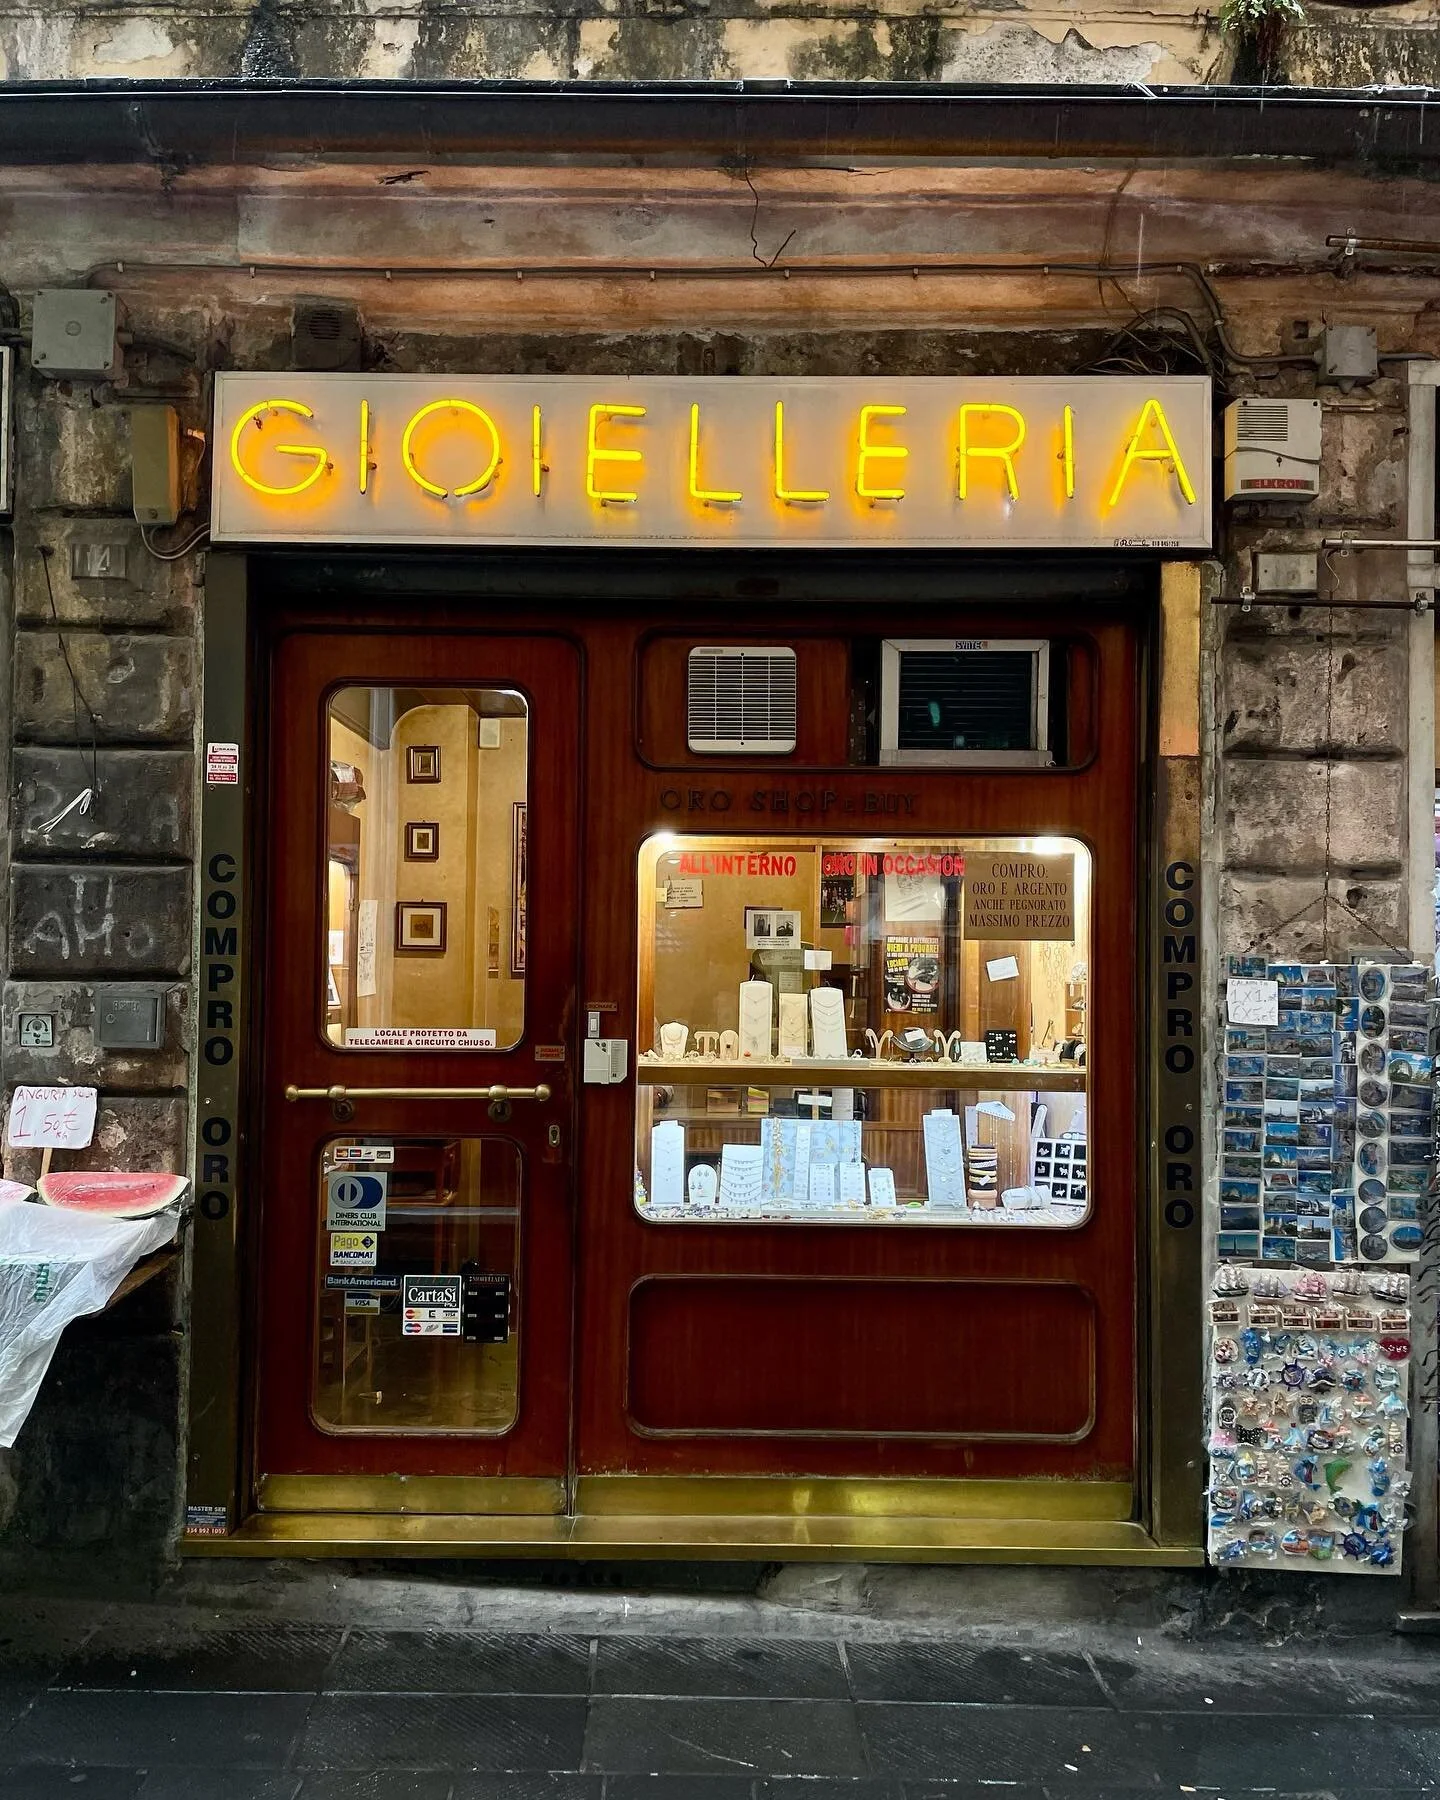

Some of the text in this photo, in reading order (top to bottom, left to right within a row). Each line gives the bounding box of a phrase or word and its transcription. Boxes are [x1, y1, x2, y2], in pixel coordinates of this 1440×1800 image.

[230, 399, 1197, 506] GIOIELLERIA
[661, 789, 731, 811] ORO
[751, 790, 837, 813] SHOP
[864, 792, 917, 815] BUY
[679, 853, 797, 877] ALL'INTERNO
[972, 881, 1067, 896] ORO E ARGENTO
[974, 899, 1066, 911] ANCHE PEGNORATO
[969, 914, 1070, 928] MASSIMO PREZZO
[202, 852, 237, 1221] COMPRO ORO
[348, 1038, 405, 1046] TELECAMERE
[1163, 860, 1196, 1229] COMPRO ORO
[333, 1235, 359, 1249] Pago
[327, 1276, 397, 1287] BankAmericard
